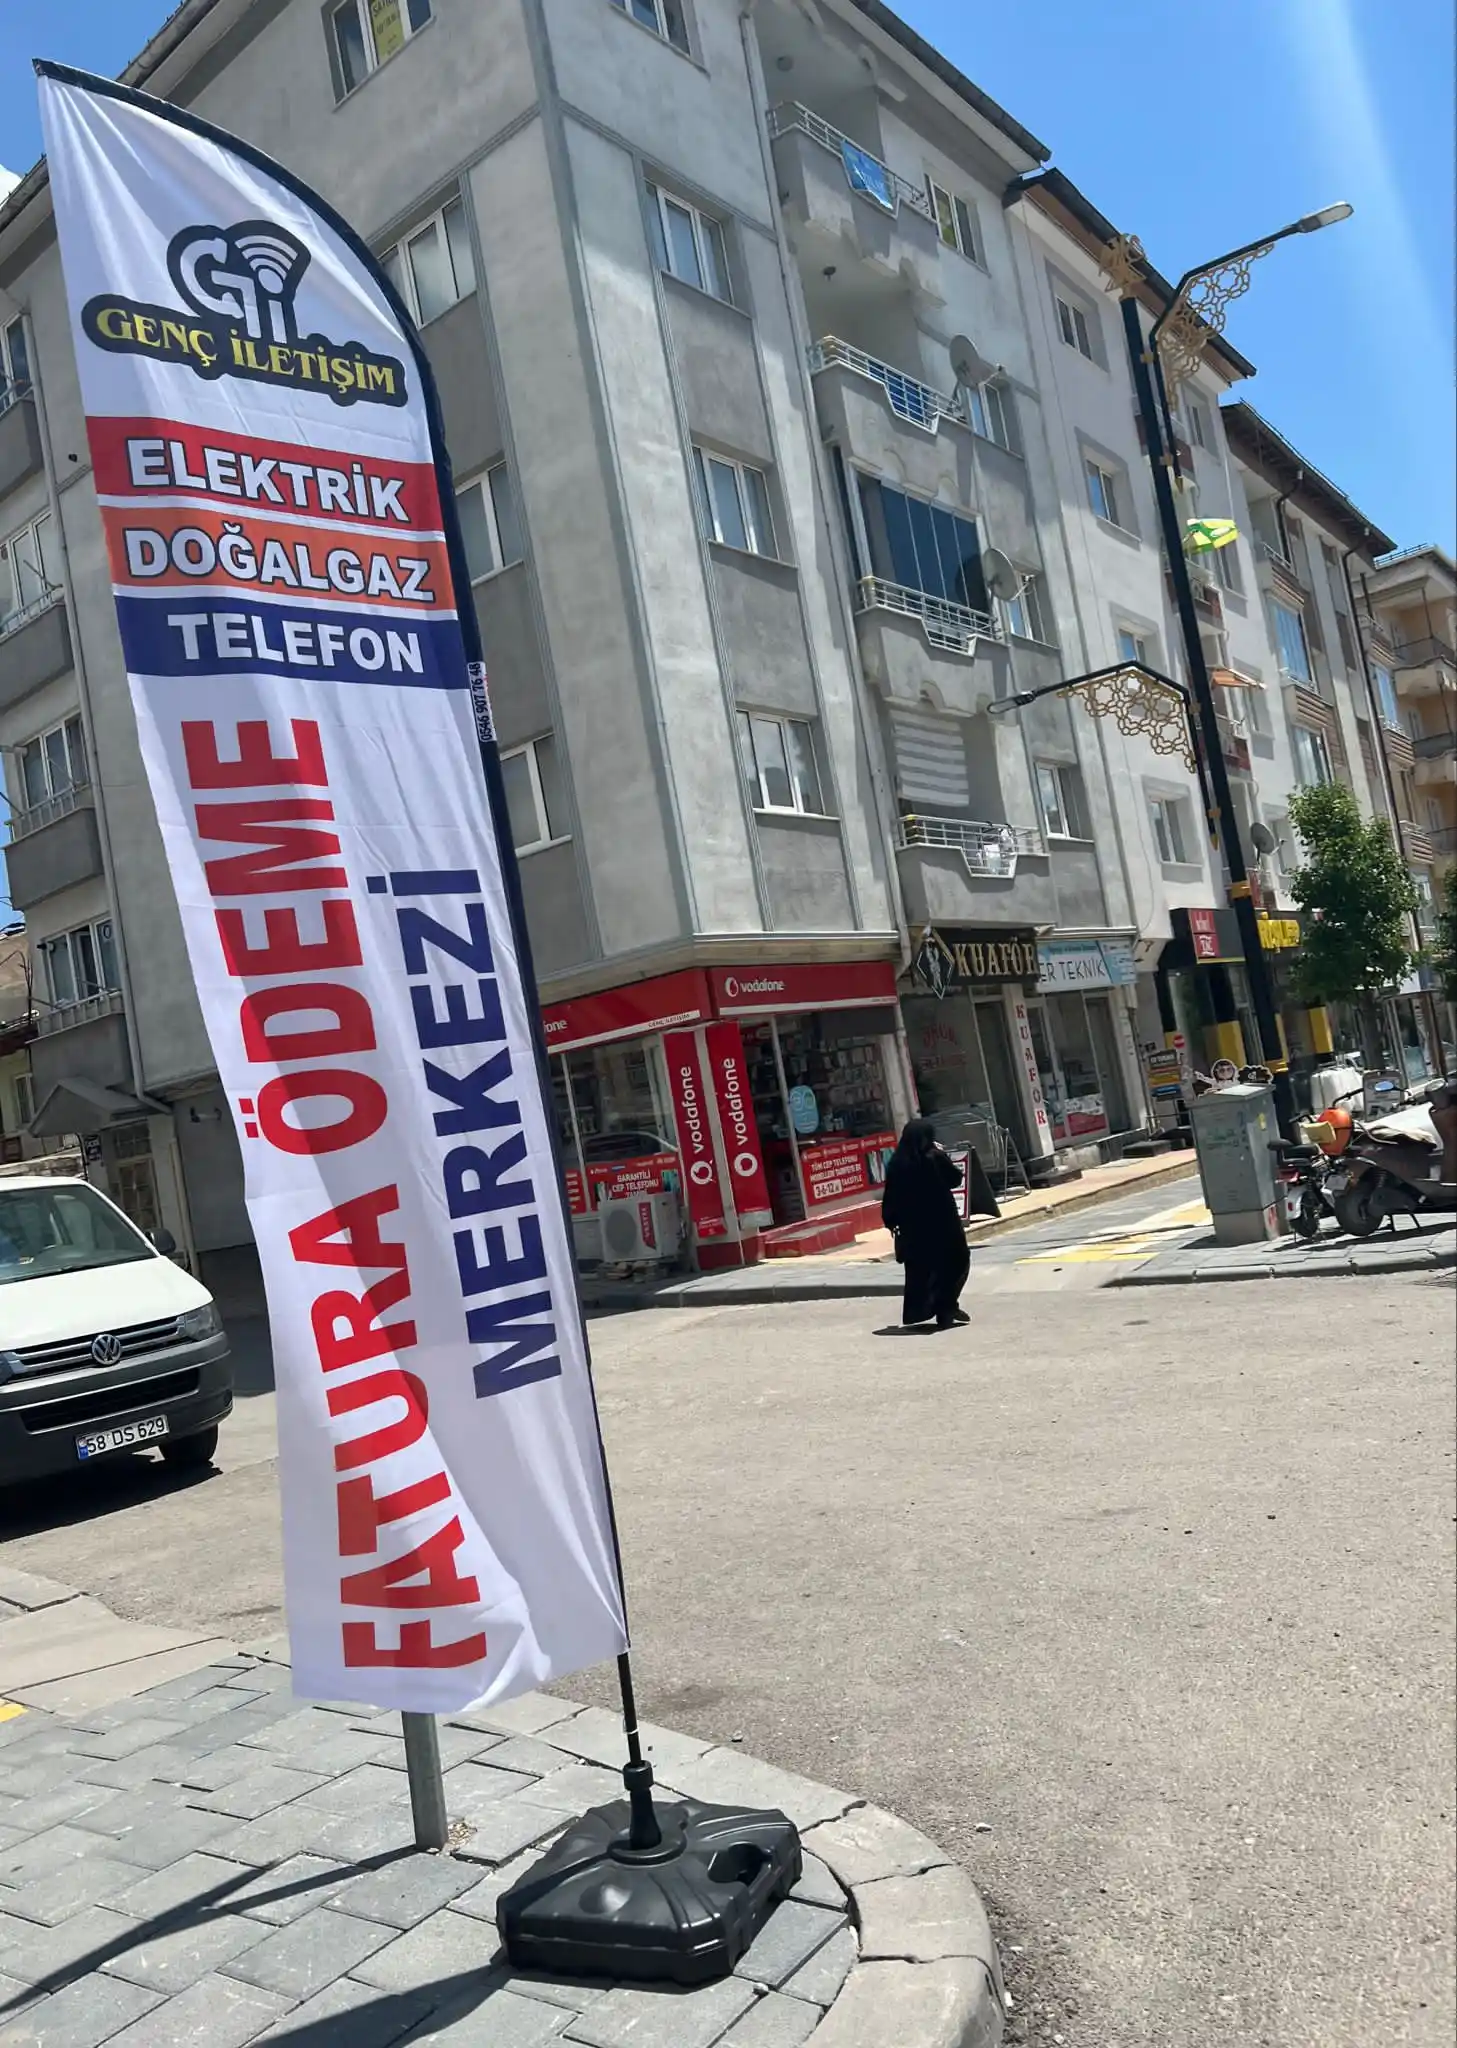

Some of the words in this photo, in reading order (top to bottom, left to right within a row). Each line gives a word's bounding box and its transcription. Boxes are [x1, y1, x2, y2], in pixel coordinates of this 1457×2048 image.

[96, 307, 218, 366] GENÇ
[228, 334, 395, 395] İLETİŞİM
[126, 437, 410, 524] ELEKTRİK
[124, 521, 436, 603] DOĞALGAZ
[167, 611, 425, 674] TELEFON
[469, 662, 482, 676] 48
[471, 678, 484, 692] 76
[474, 695, 488, 713] 907
[478, 715, 492, 740] 0546
[180, 719, 388, 1157] ÖDEME
[953, 936, 1038, 978] KUAFÖR
[740, 979, 786, 993] vodafone
[1061, 957, 1105, 983] TEKNİK
[680, 1066, 704, 1154] vodafone
[723, 1058, 748, 1146] vodafone
[366, 869, 562, 1400] MERKEZİ
[87, 1436, 106, 1453] 58
[112, 1427, 134, 1445] DS
[138, 1417, 165, 1438] 629
[288, 1183, 487, 1668] FATURA
